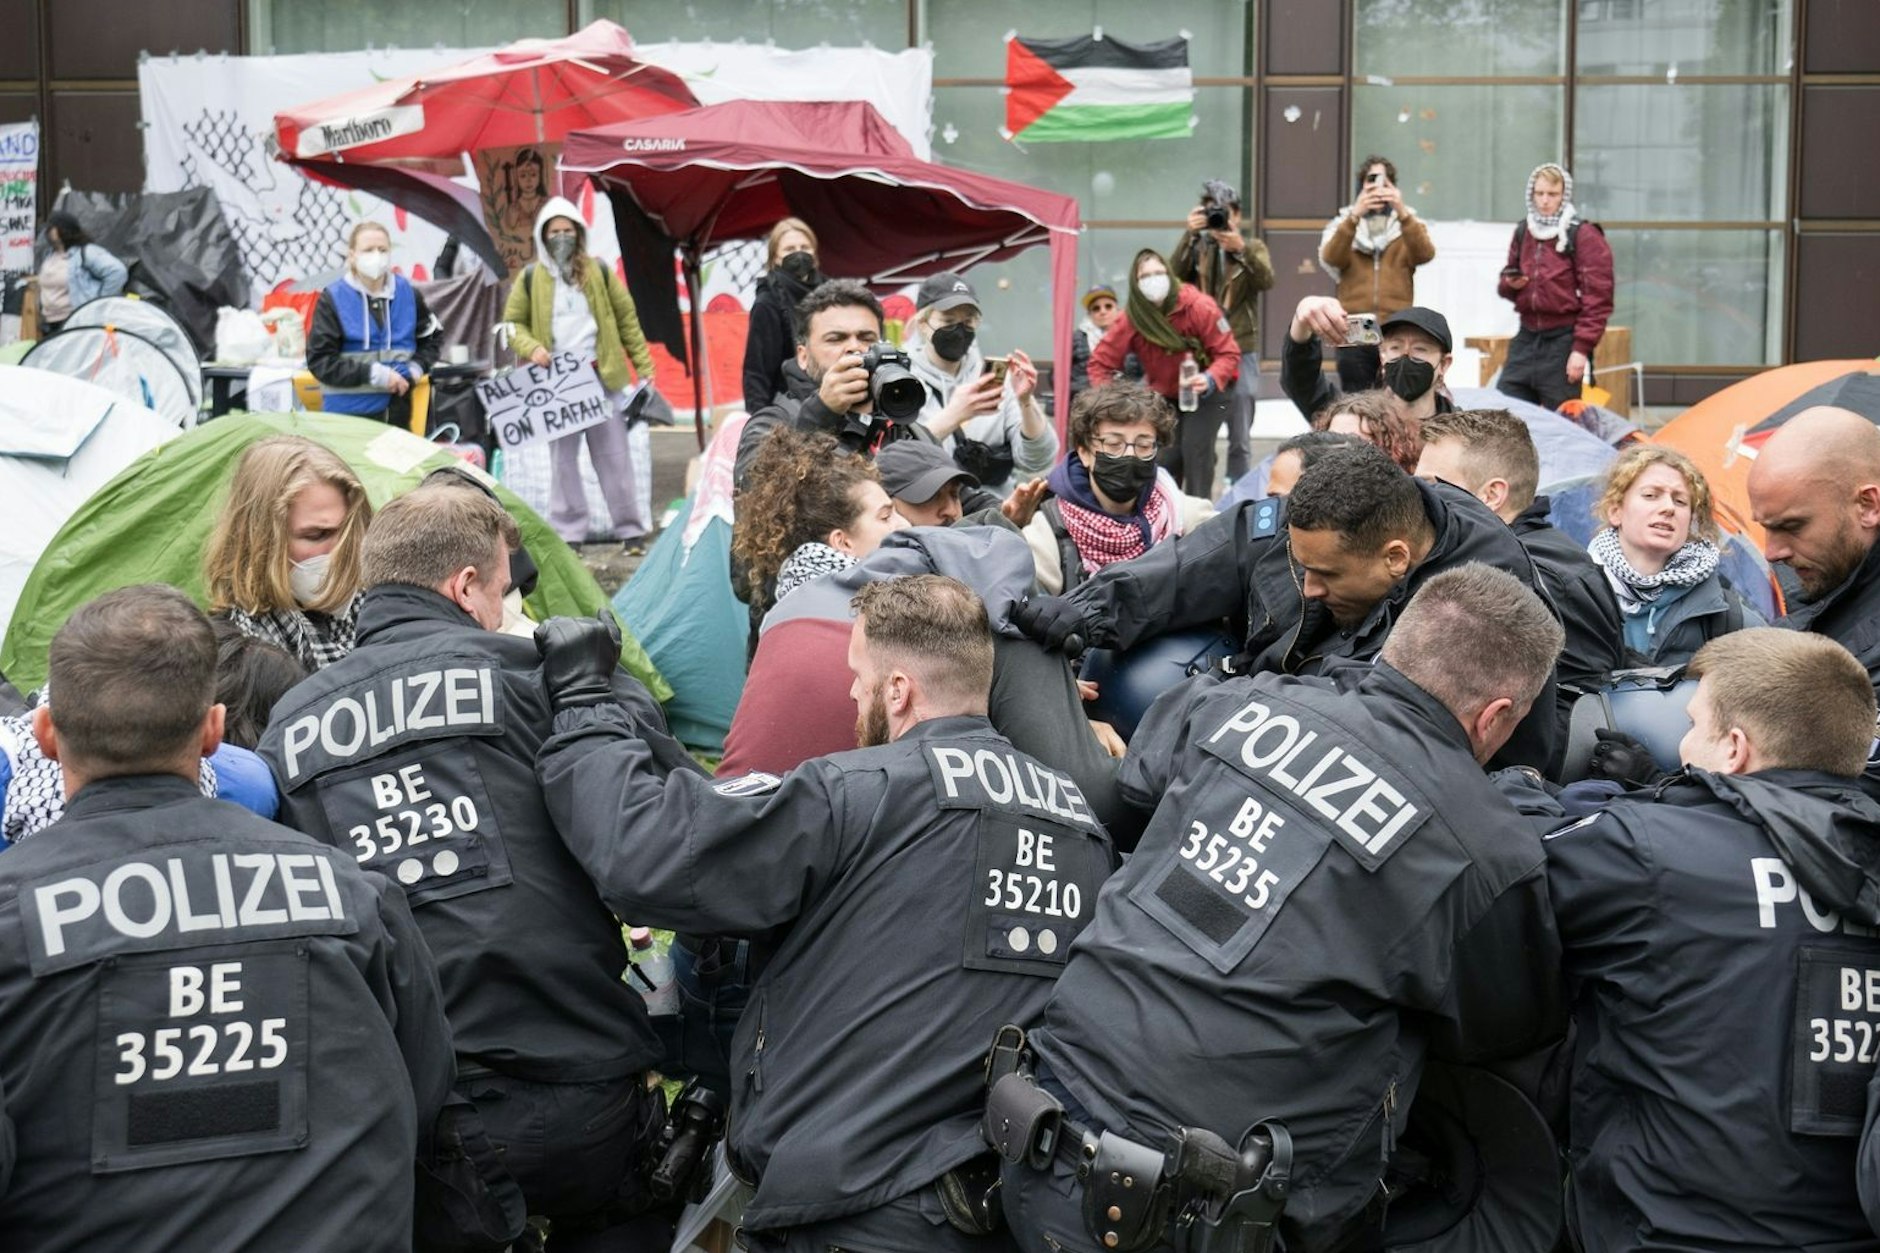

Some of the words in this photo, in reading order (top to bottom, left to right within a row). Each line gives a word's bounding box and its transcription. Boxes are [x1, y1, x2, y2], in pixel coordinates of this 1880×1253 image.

[321, 117, 392, 150] Marlboro
[623, 137, 686, 151] CASARIA
[483, 376, 522, 405] ALL
[527, 352, 579, 384] EYES
[503, 416, 535, 446] ON
[543, 395, 603, 434] RAFAH
[284, 668, 494, 779] POLIZEI
[371, 763, 432, 810] BE
[932, 747, 1098, 829] POLIZE
[1209, 701, 1418, 855] POLIZEI
[349, 795, 479, 863] 35230
[1015, 828, 1056, 872] BE
[1228, 796, 1285, 854] BE
[1179, 819, 1280, 910] 35235
[35, 853, 345, 957] POLIZEI
[984, 868, 1081, 919] 35210
[169, 962, 244, 1018] BE
[1841, 967, 1880, 1012] BE
[114, 1018, 288, 1085] 35225
